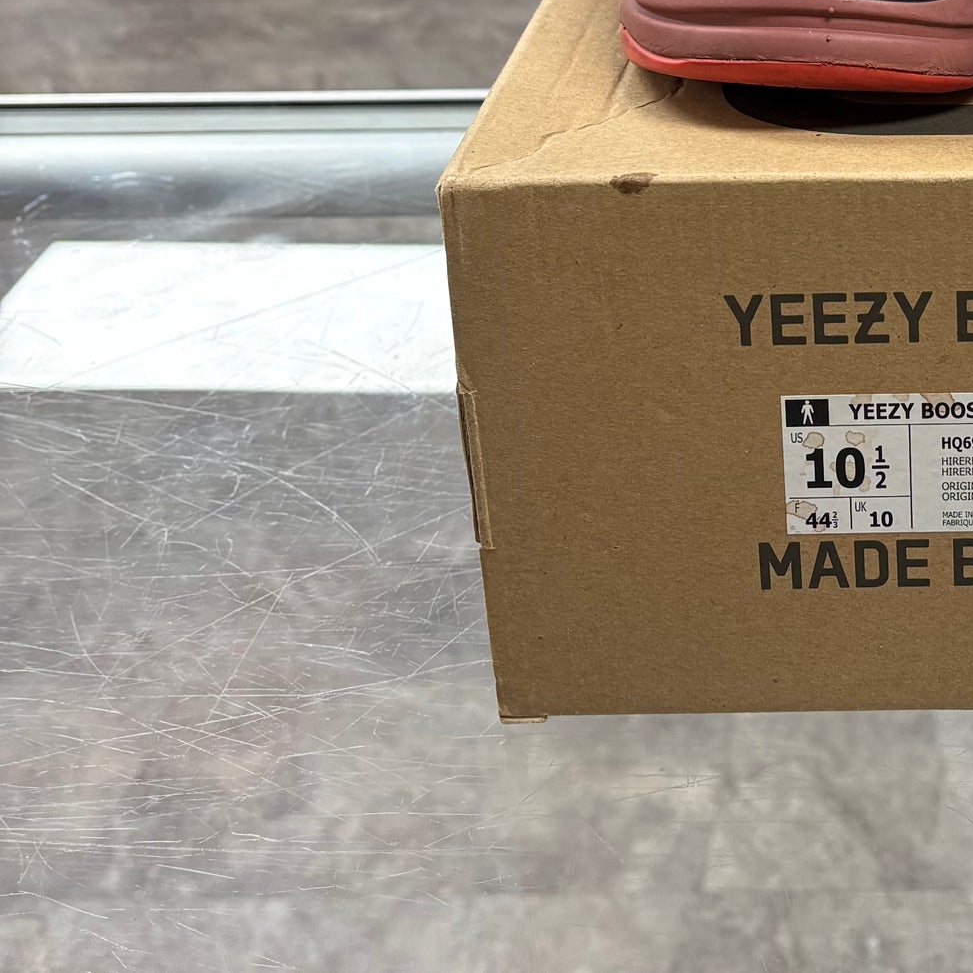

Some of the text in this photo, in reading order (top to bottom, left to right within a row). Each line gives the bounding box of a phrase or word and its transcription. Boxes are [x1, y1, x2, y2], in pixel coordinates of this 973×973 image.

[723, 290, 933, 347] YEEZY
[849, 402, 914, 420] YEEZY
[790, 432, 804, 444] US
[805, 447, 866, 489] 10
[854, 501, 867, 512] UK
[869, 511, 894, 528] 10
[758, 539, 930, 591] MADE
